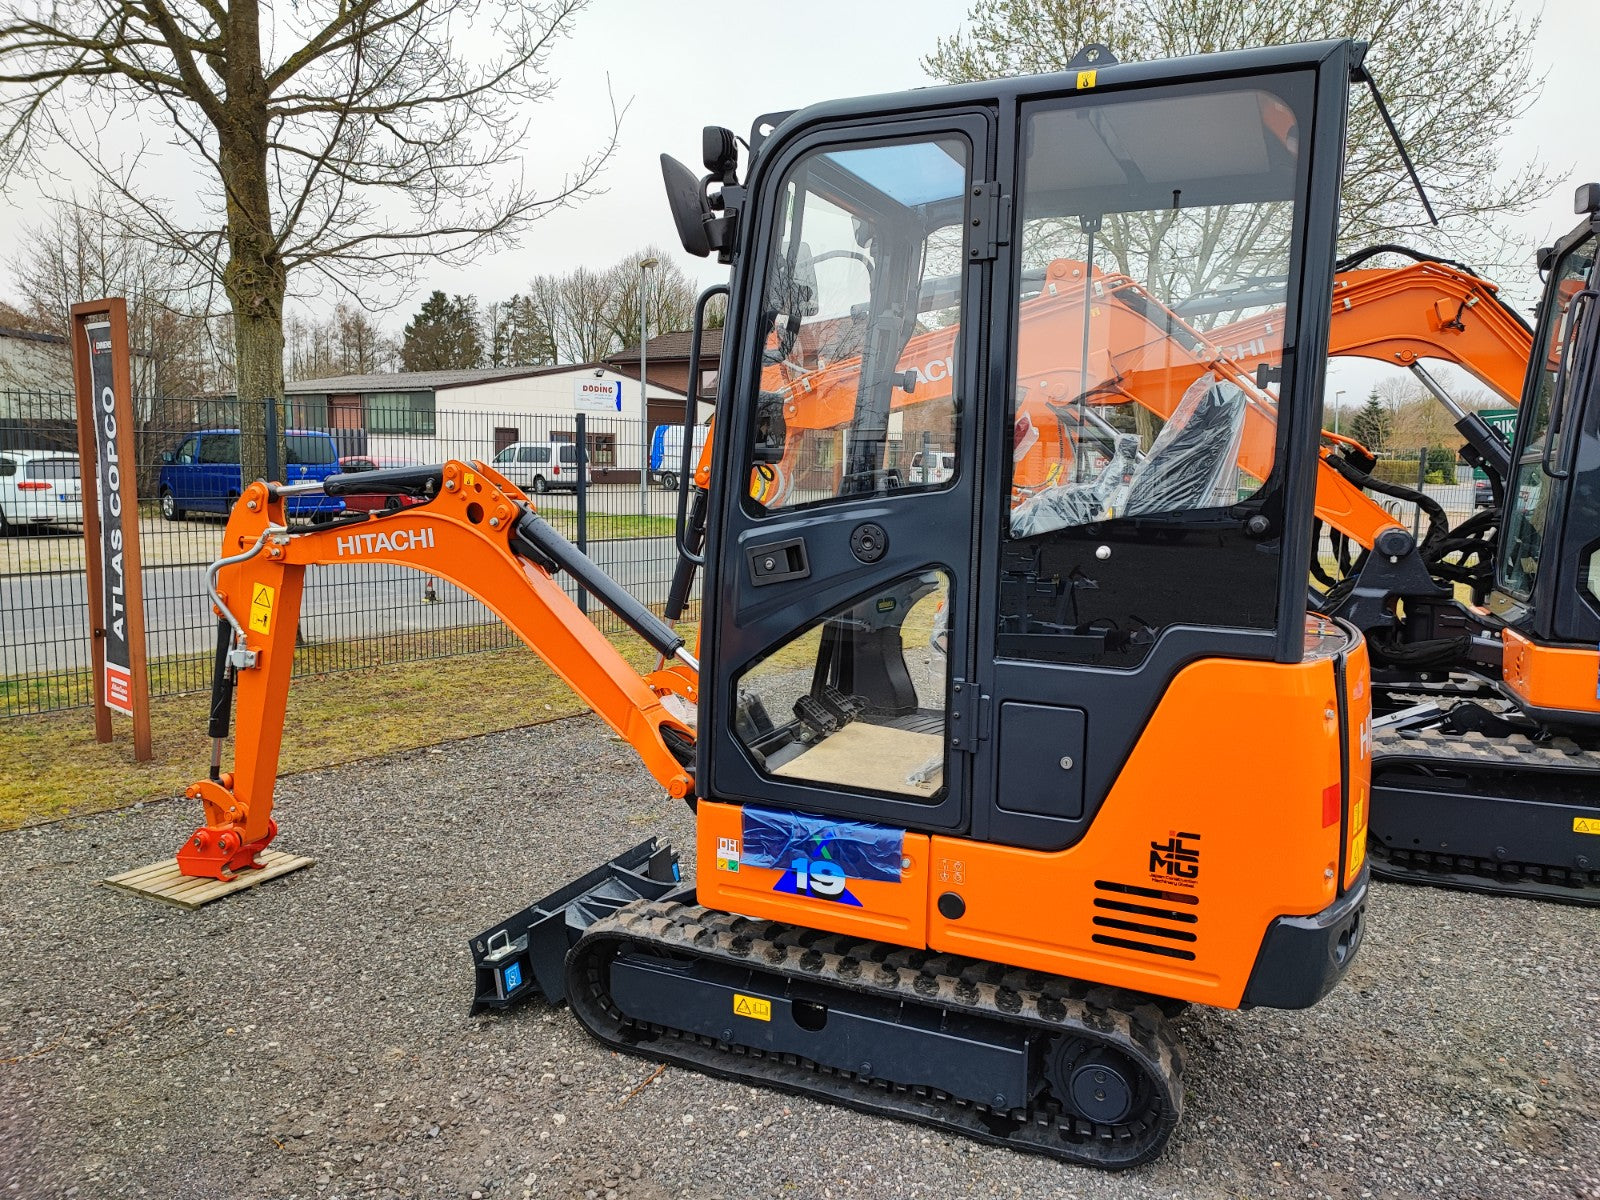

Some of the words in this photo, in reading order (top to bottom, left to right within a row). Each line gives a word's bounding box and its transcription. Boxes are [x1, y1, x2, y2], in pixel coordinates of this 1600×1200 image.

[102, 386, 121, 517] COPCO
[336, 527, 435, 556] HITACHI
[111, 528, 124, 642] ATLAS
[791, 857, 847, 897] 19
[1149, 850, 1198, 878] MG
